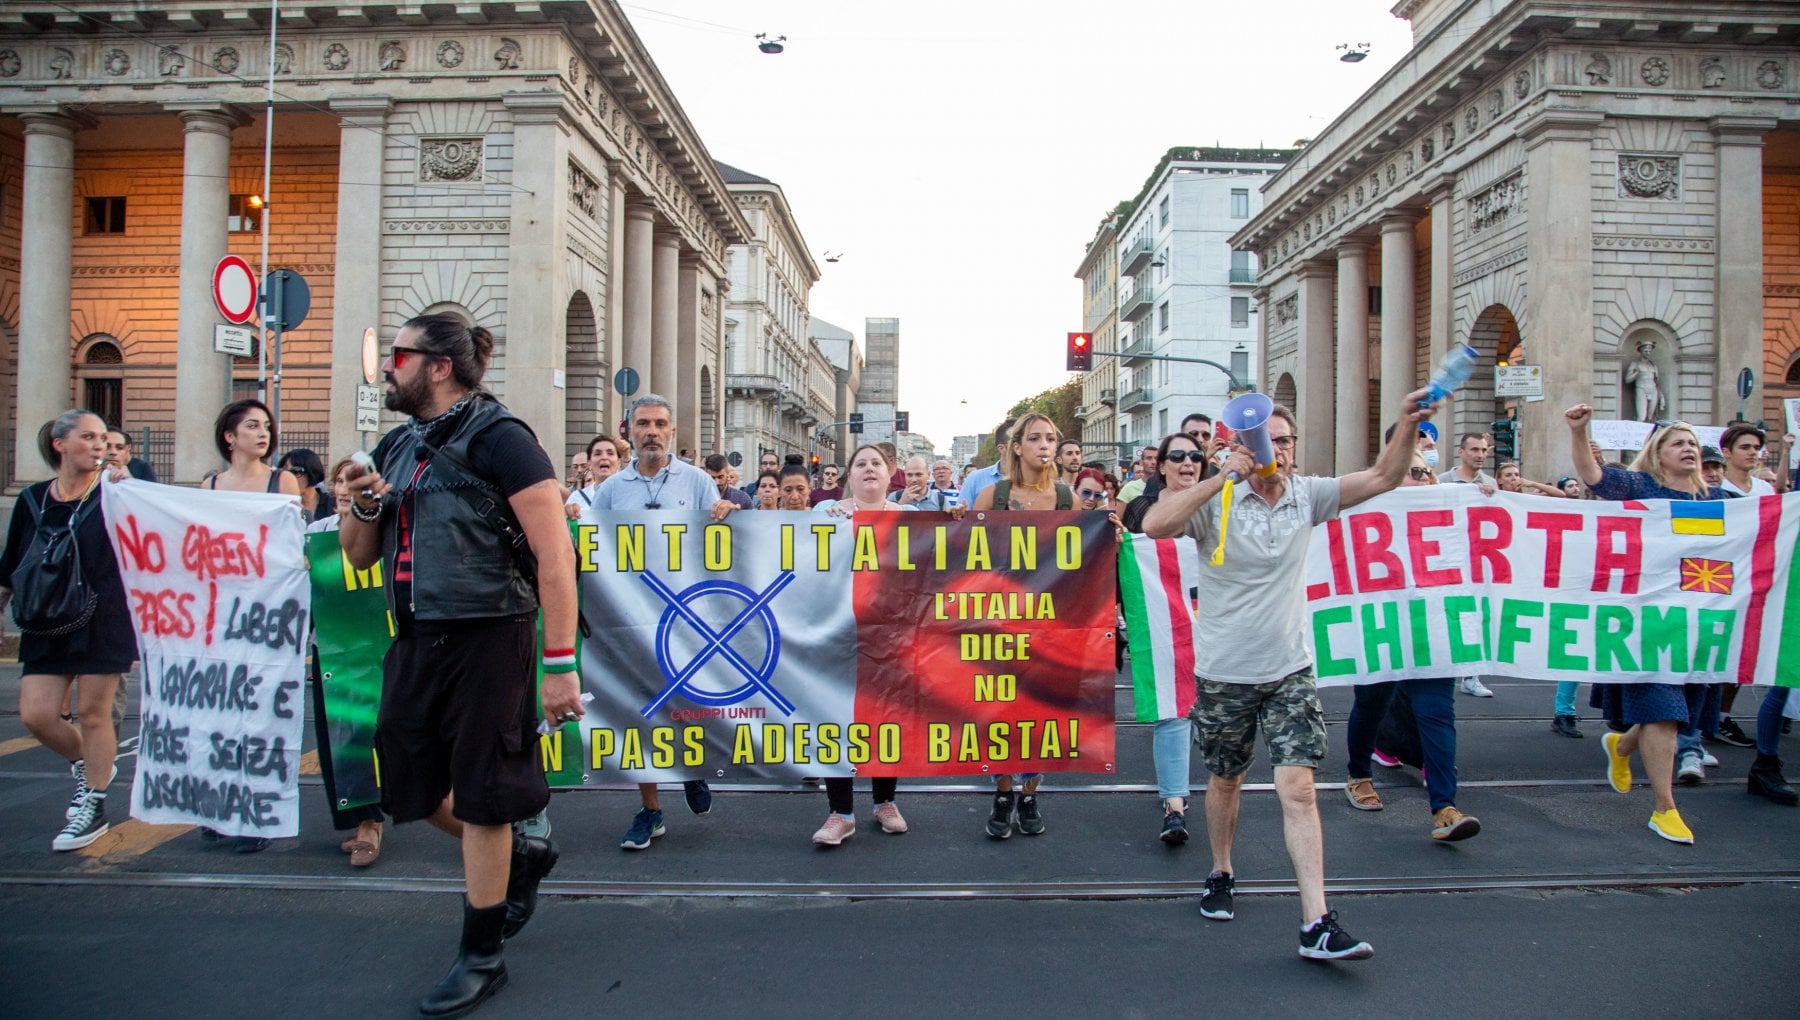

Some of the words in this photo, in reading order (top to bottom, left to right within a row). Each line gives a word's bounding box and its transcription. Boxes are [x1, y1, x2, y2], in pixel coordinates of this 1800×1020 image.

[115, 514, 166, 574] NO
[181, 523, 269, 581] GREEN
[780, 523, 1083, 572] ITALIANO
[224, 596, 307, 655] LIBERI
[934, 591, 1057, 621] L'ITALIA
[959, 632, 1031, 662] DICE
[159, 656, 263, 712] LAVORARE
[273, 680, 300, 719] E
[974, 673, 1017, 703] NO
[669, 708, 726, 721] GRUPPI
[728, 706, 767, 720] UNITI
[208, 731, 288, 784] SENZA
[590, 725, 706, 771] PASS
[731, 722, 901, 766] ADESSO
[927, 718, 1080, 764] BASTA!
